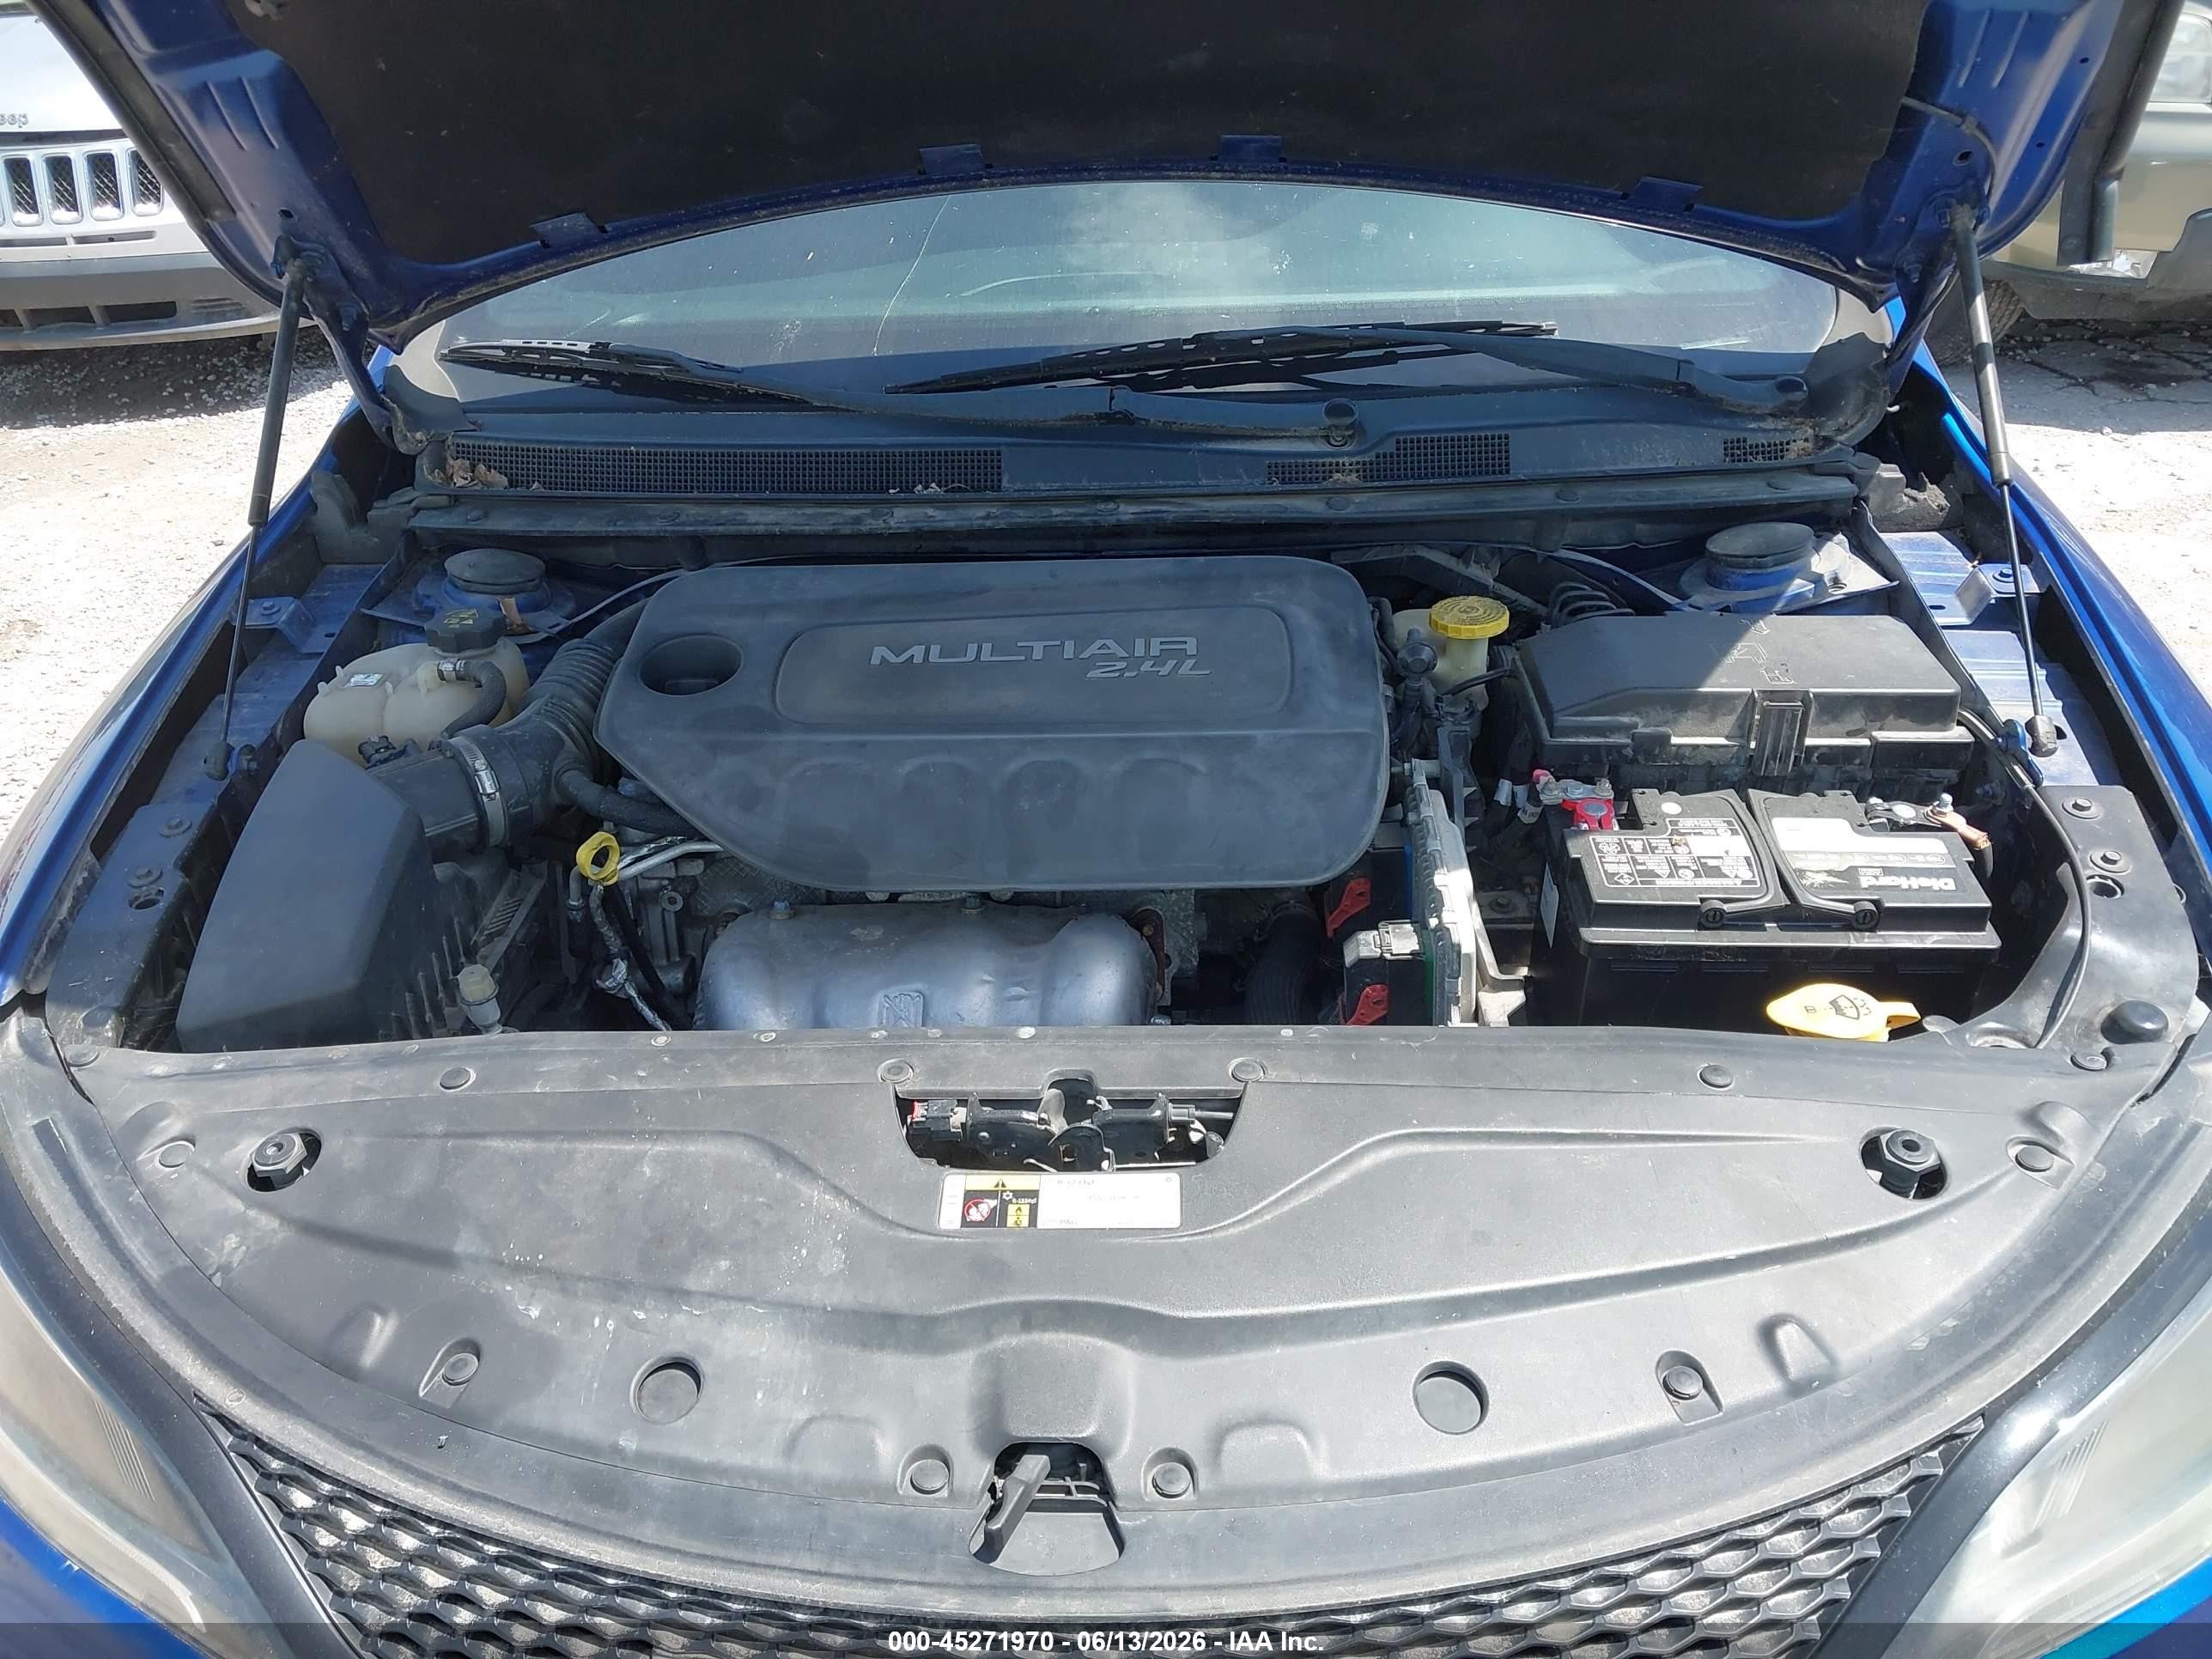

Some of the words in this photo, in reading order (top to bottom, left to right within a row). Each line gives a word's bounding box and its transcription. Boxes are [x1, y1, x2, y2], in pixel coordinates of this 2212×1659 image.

[0, 112, 29, 128] eep
[869, 637, 1198, 665] MULTIAIR
[1085, 659, 1212, 678] 2.4L
[1858, 876, 1957, 890] DieHard
